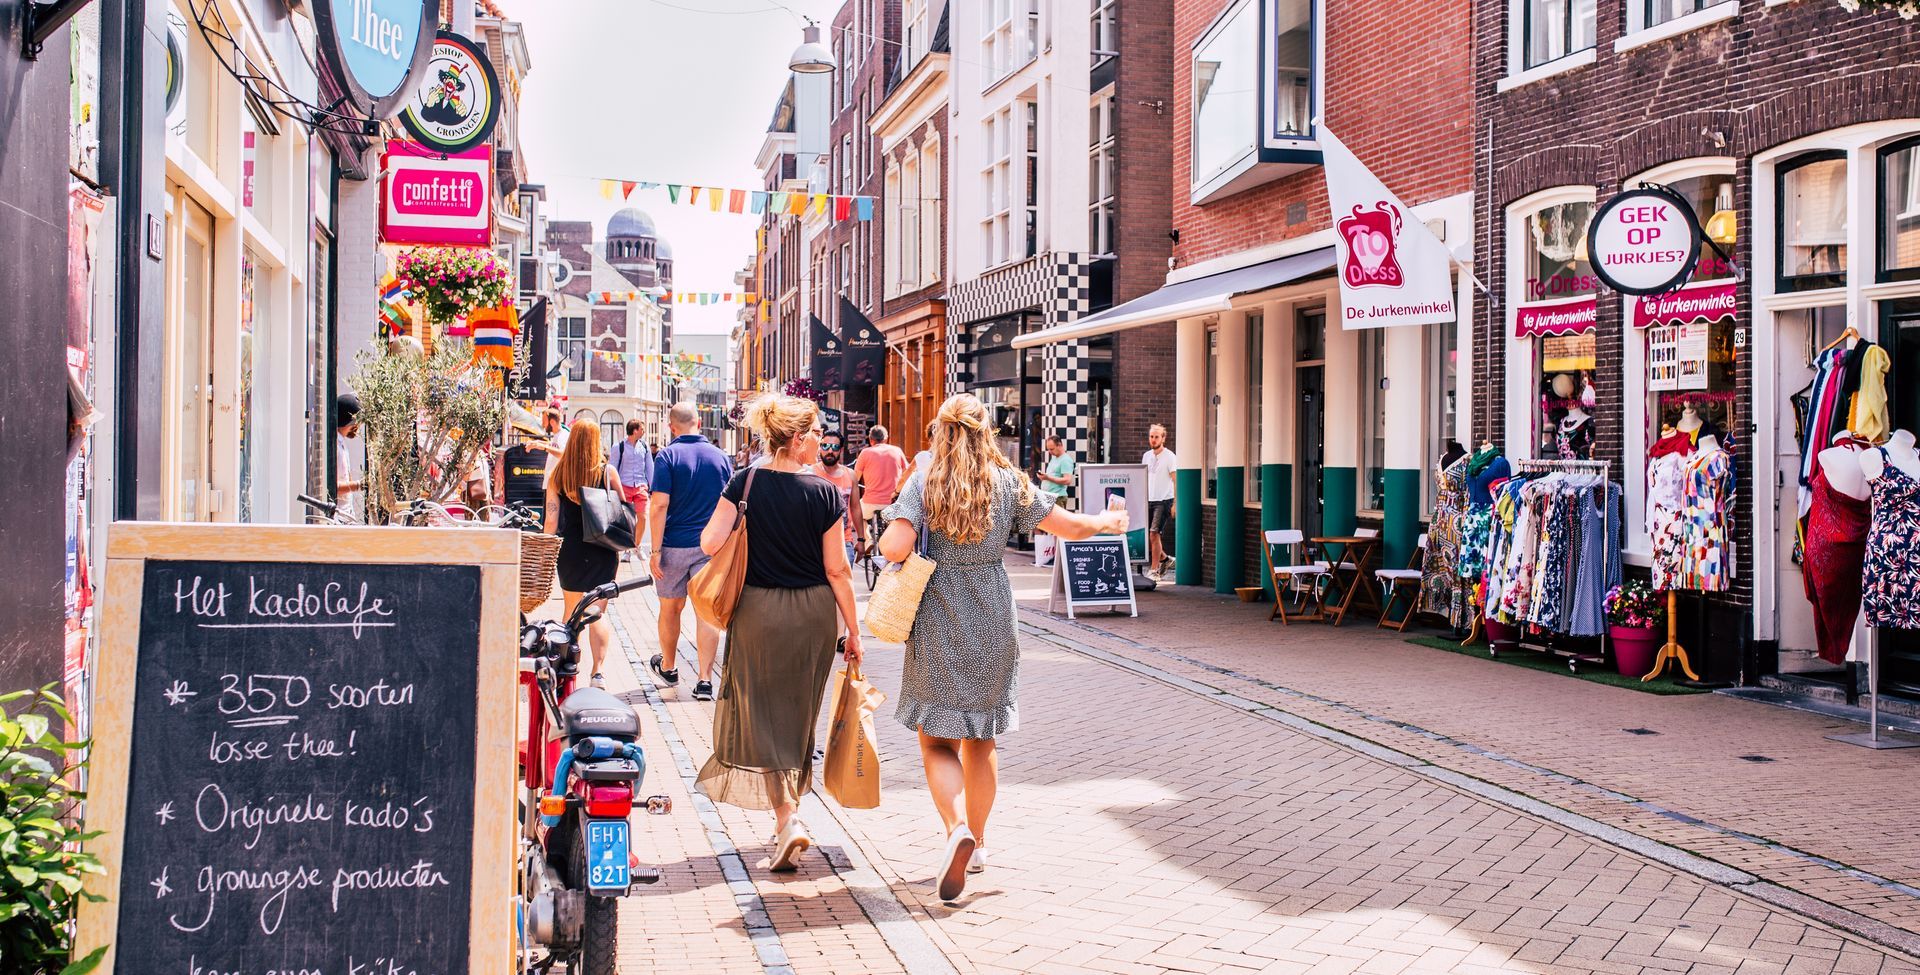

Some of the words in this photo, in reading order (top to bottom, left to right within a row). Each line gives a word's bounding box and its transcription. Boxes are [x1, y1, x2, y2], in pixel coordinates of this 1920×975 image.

[349, 0, 403, 60] Thee
[433, 47, 463, 59] ESHOP
[436, 110, 480, 137] GRONINGEN
[403, 177, 473, 208] confetti
[1619, 205, 1668, 224] GEK
[1627, 227, 1661, 245] OP
[1604, 250, 1685, 265] JURKJES?
[1528, 278, 1546, 297] To
[1347, 306, 1365, 319] De
[1369, 300, 1451, 318] Jurkenwinkel
[1657, 293, 1736, 318] jurkenwinke
[1534, 307, 1596, 330] jurkenwinke
[1735, 332, 1744, 344] 29
[175, 576, 232, 617] Het
[218, 674, 311, 714] 350
[327, 679, 414, 709] soorten
[210, 731, 273, 763] losse
[282, 730, 357, 760] thee!
[196, 783, 331, 849] Originele
[591, 827, 623, 843] FH1
[592, 865, 626, 883] 82T
[170, 865, 322, 934] groningse
[332, 859, 449, 913] producten
